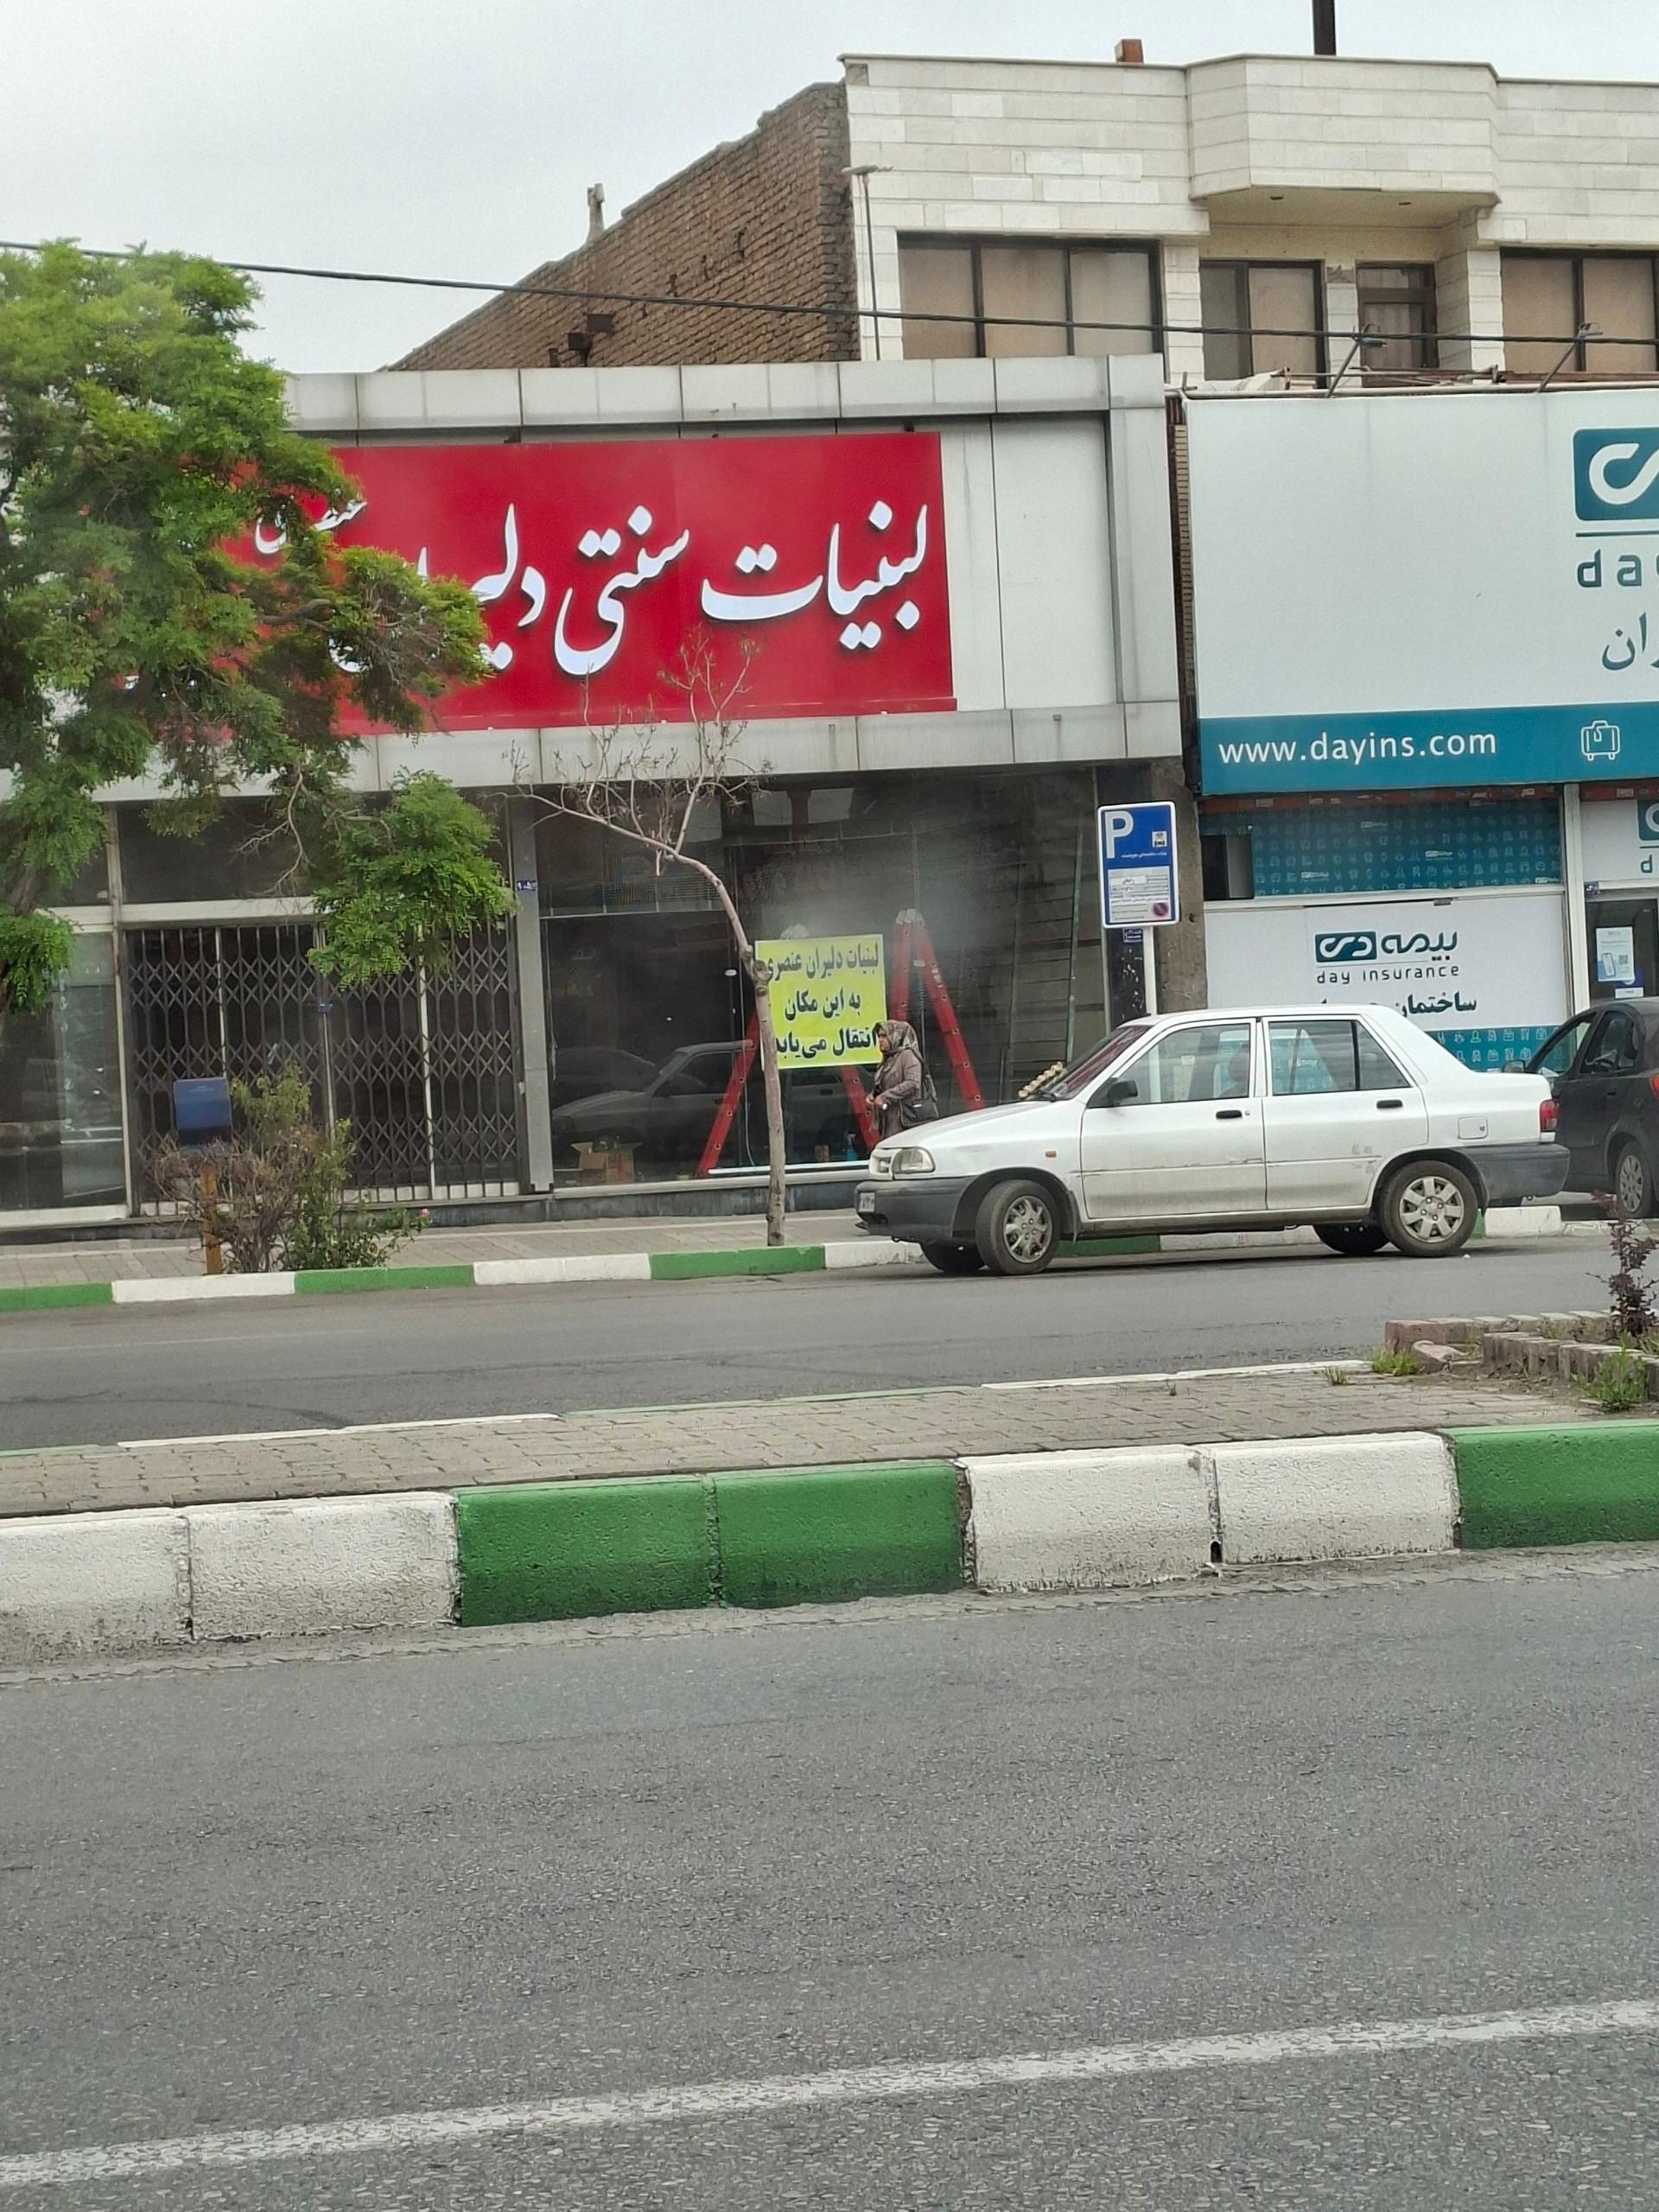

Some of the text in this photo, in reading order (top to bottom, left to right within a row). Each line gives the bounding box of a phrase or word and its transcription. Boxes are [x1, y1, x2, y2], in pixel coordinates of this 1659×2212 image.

[702, 499, 929, 651] لبنیات
[1577, 548, 1659, 588] da
[554, 504, 690, 677] سنتی
[1217, 731, 1497, 769] www.dayins.com
[1104, 810, 1134, 859] P
[805, 944, 843, 980] دلیران
[847, 942, 879, 975] لبنیات
[1381, 931, 1458, 961] بیمه
[1316, 965, 1459, 985] day insurance
[785, 988, 861, 1021] به این مکان
[832, 1026, 877, 1057] انتقال
